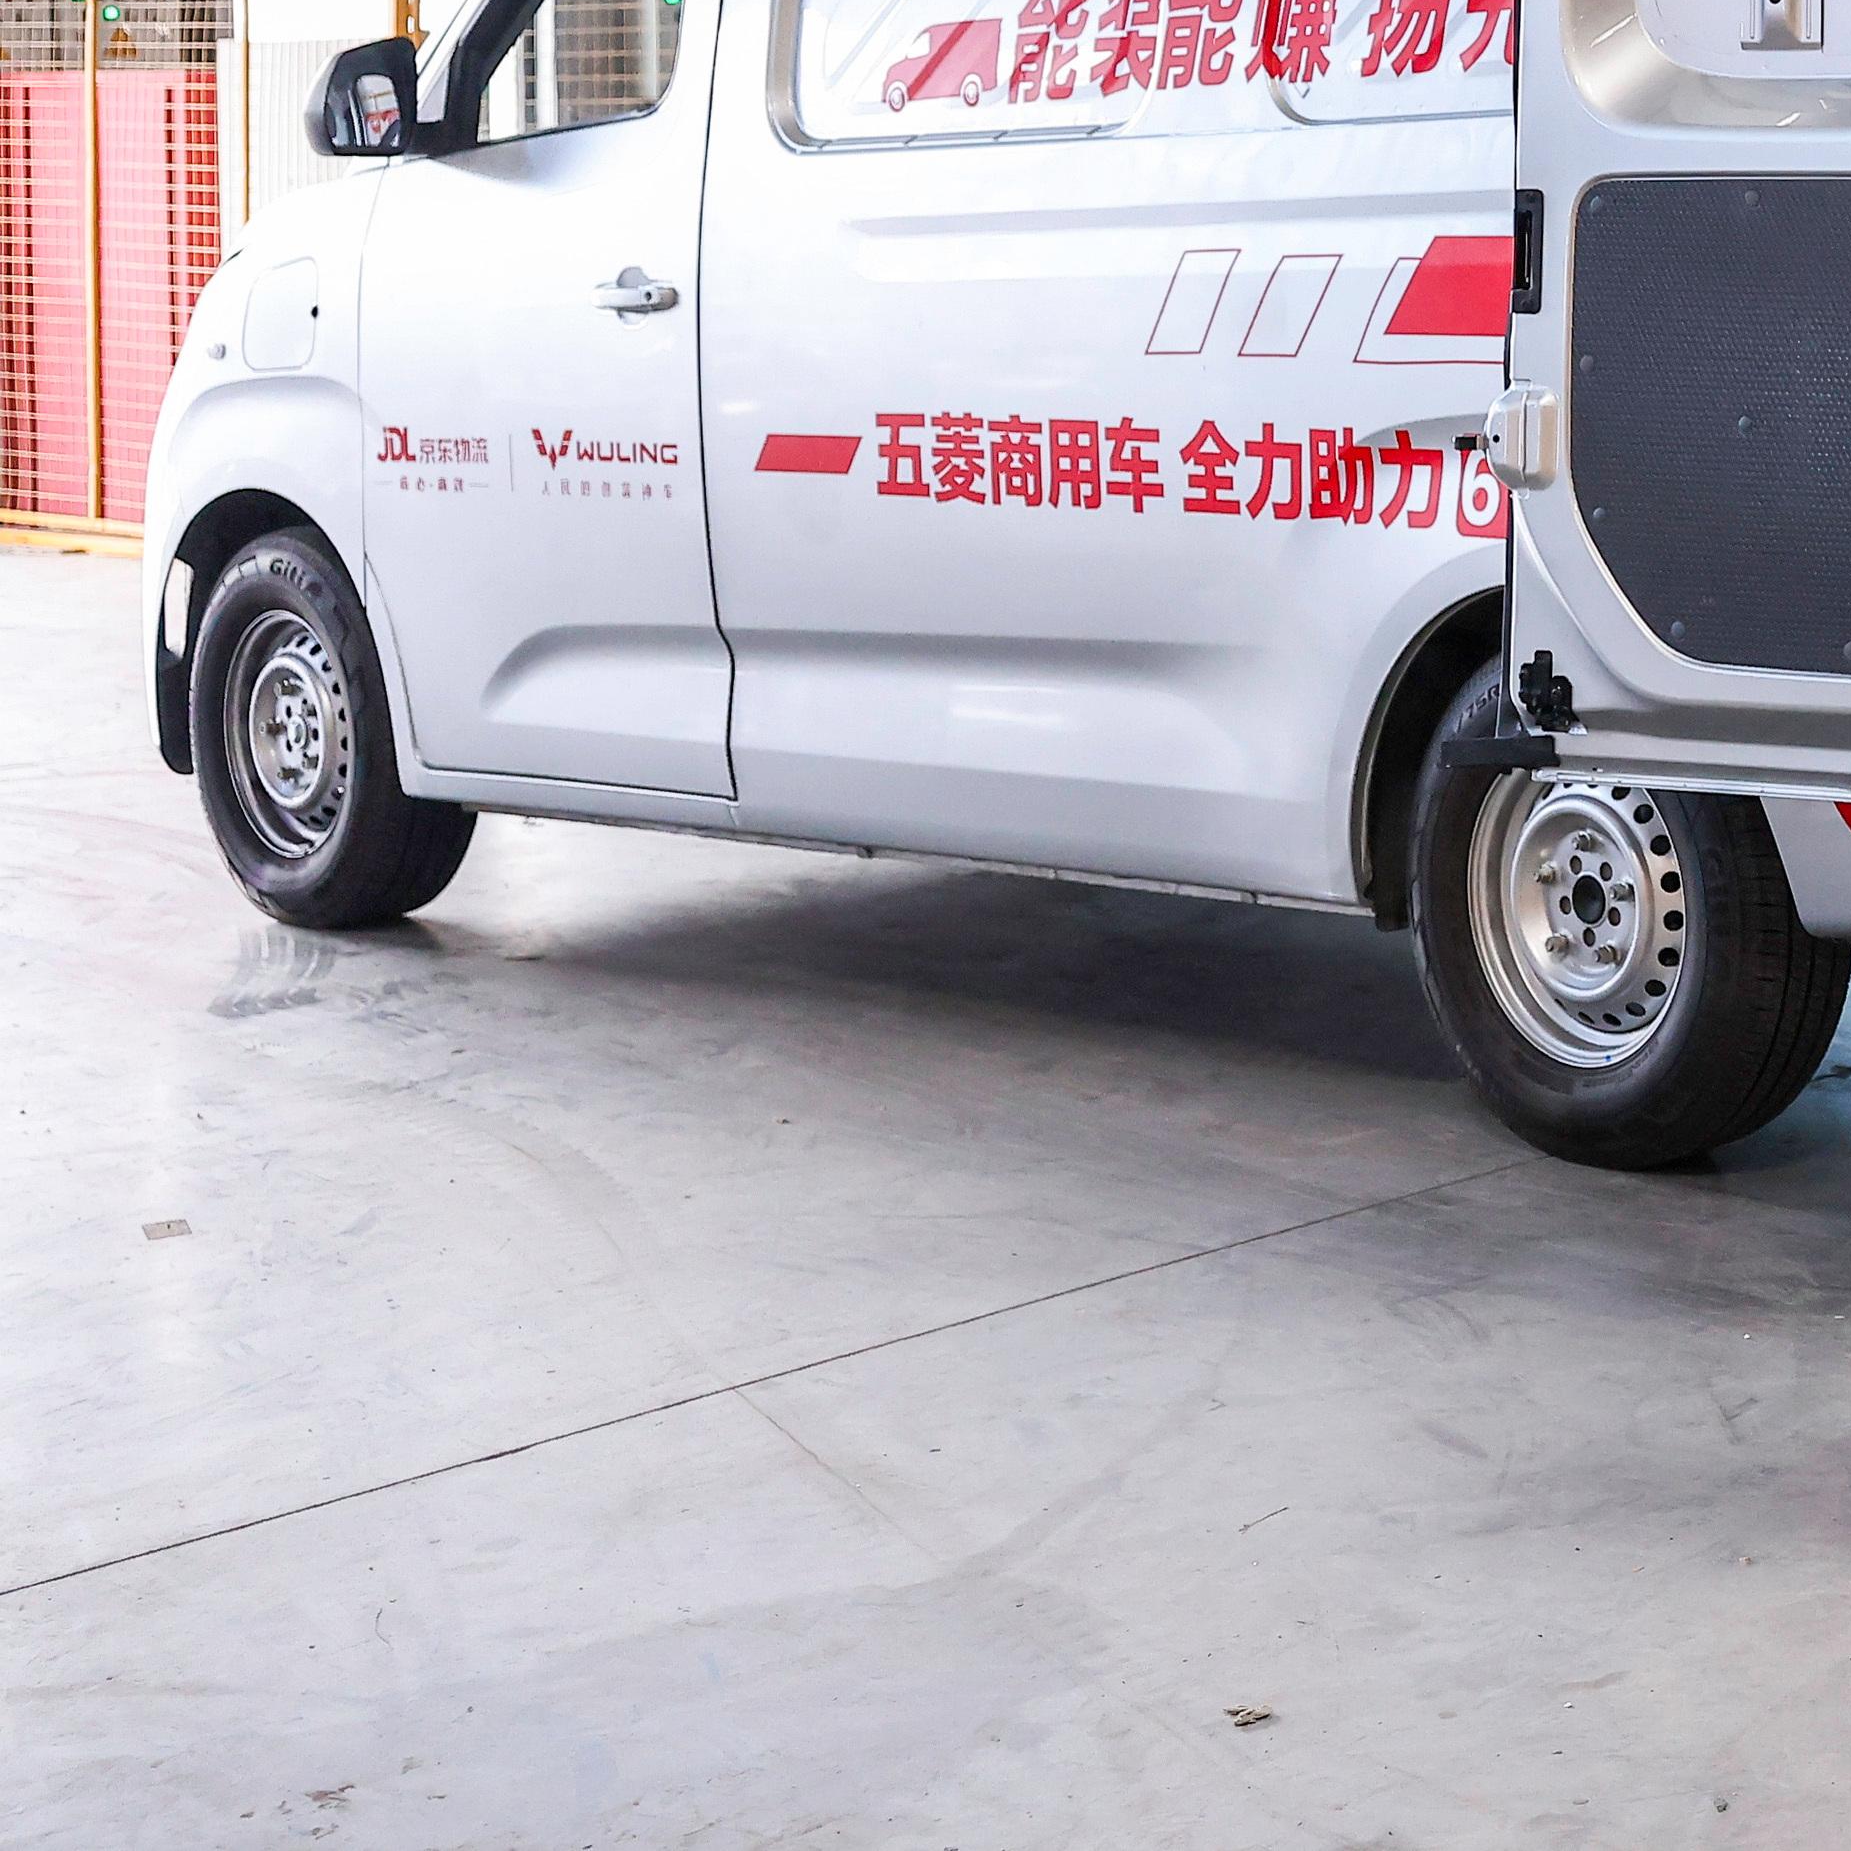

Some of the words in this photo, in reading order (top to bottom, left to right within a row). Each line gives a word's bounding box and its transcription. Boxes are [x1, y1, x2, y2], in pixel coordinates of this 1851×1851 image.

[377, 426, 417, 462] JDL
[418, 436, 490, 465] 京东物流
[575, 440, 679, 465] WULING
[873, 413, 1166, 514] 五菱商用车
